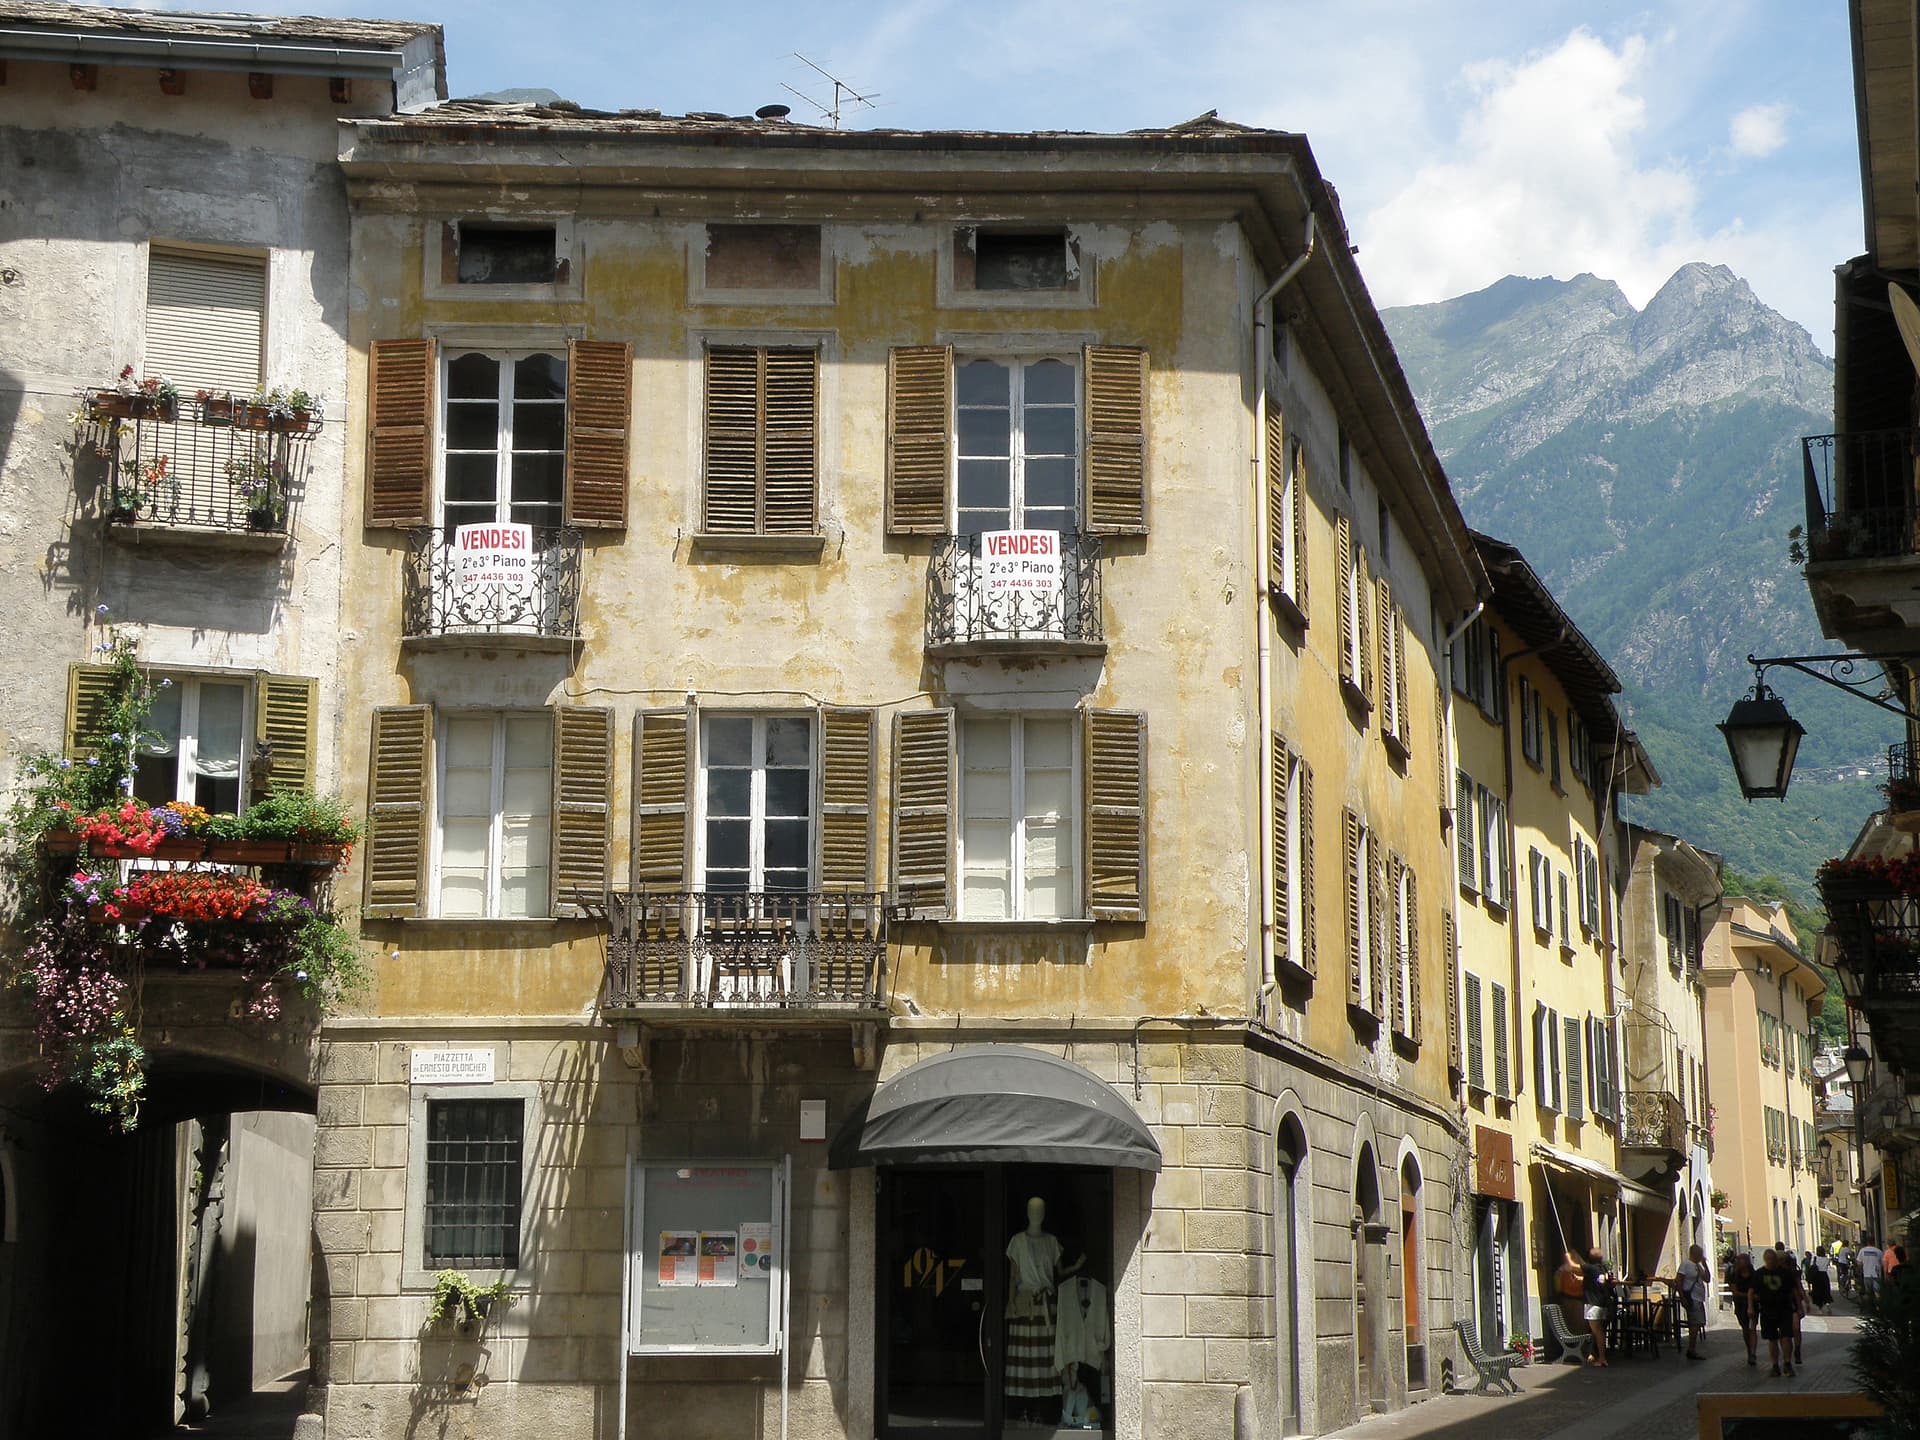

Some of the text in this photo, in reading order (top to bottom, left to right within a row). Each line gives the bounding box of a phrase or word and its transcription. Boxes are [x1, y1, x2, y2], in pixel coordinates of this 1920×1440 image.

[461, 529, 525, 550] VENDESI
[988, 535, 1053, 555] VENDESI
[473, 560, 477, 568] e
[493, 555, 526, 567] Piano
[1022, 561, 1054, 573] Piano
[463, 573, 523, 582] 347 4436 303
[991, 580, 1007, 588] 347
[1010, 579, 1032, 587] 4436
[433, 1053, 473, 1062] PIAZZETTA
[420, 1064, 450, 1072] ERNESTO
